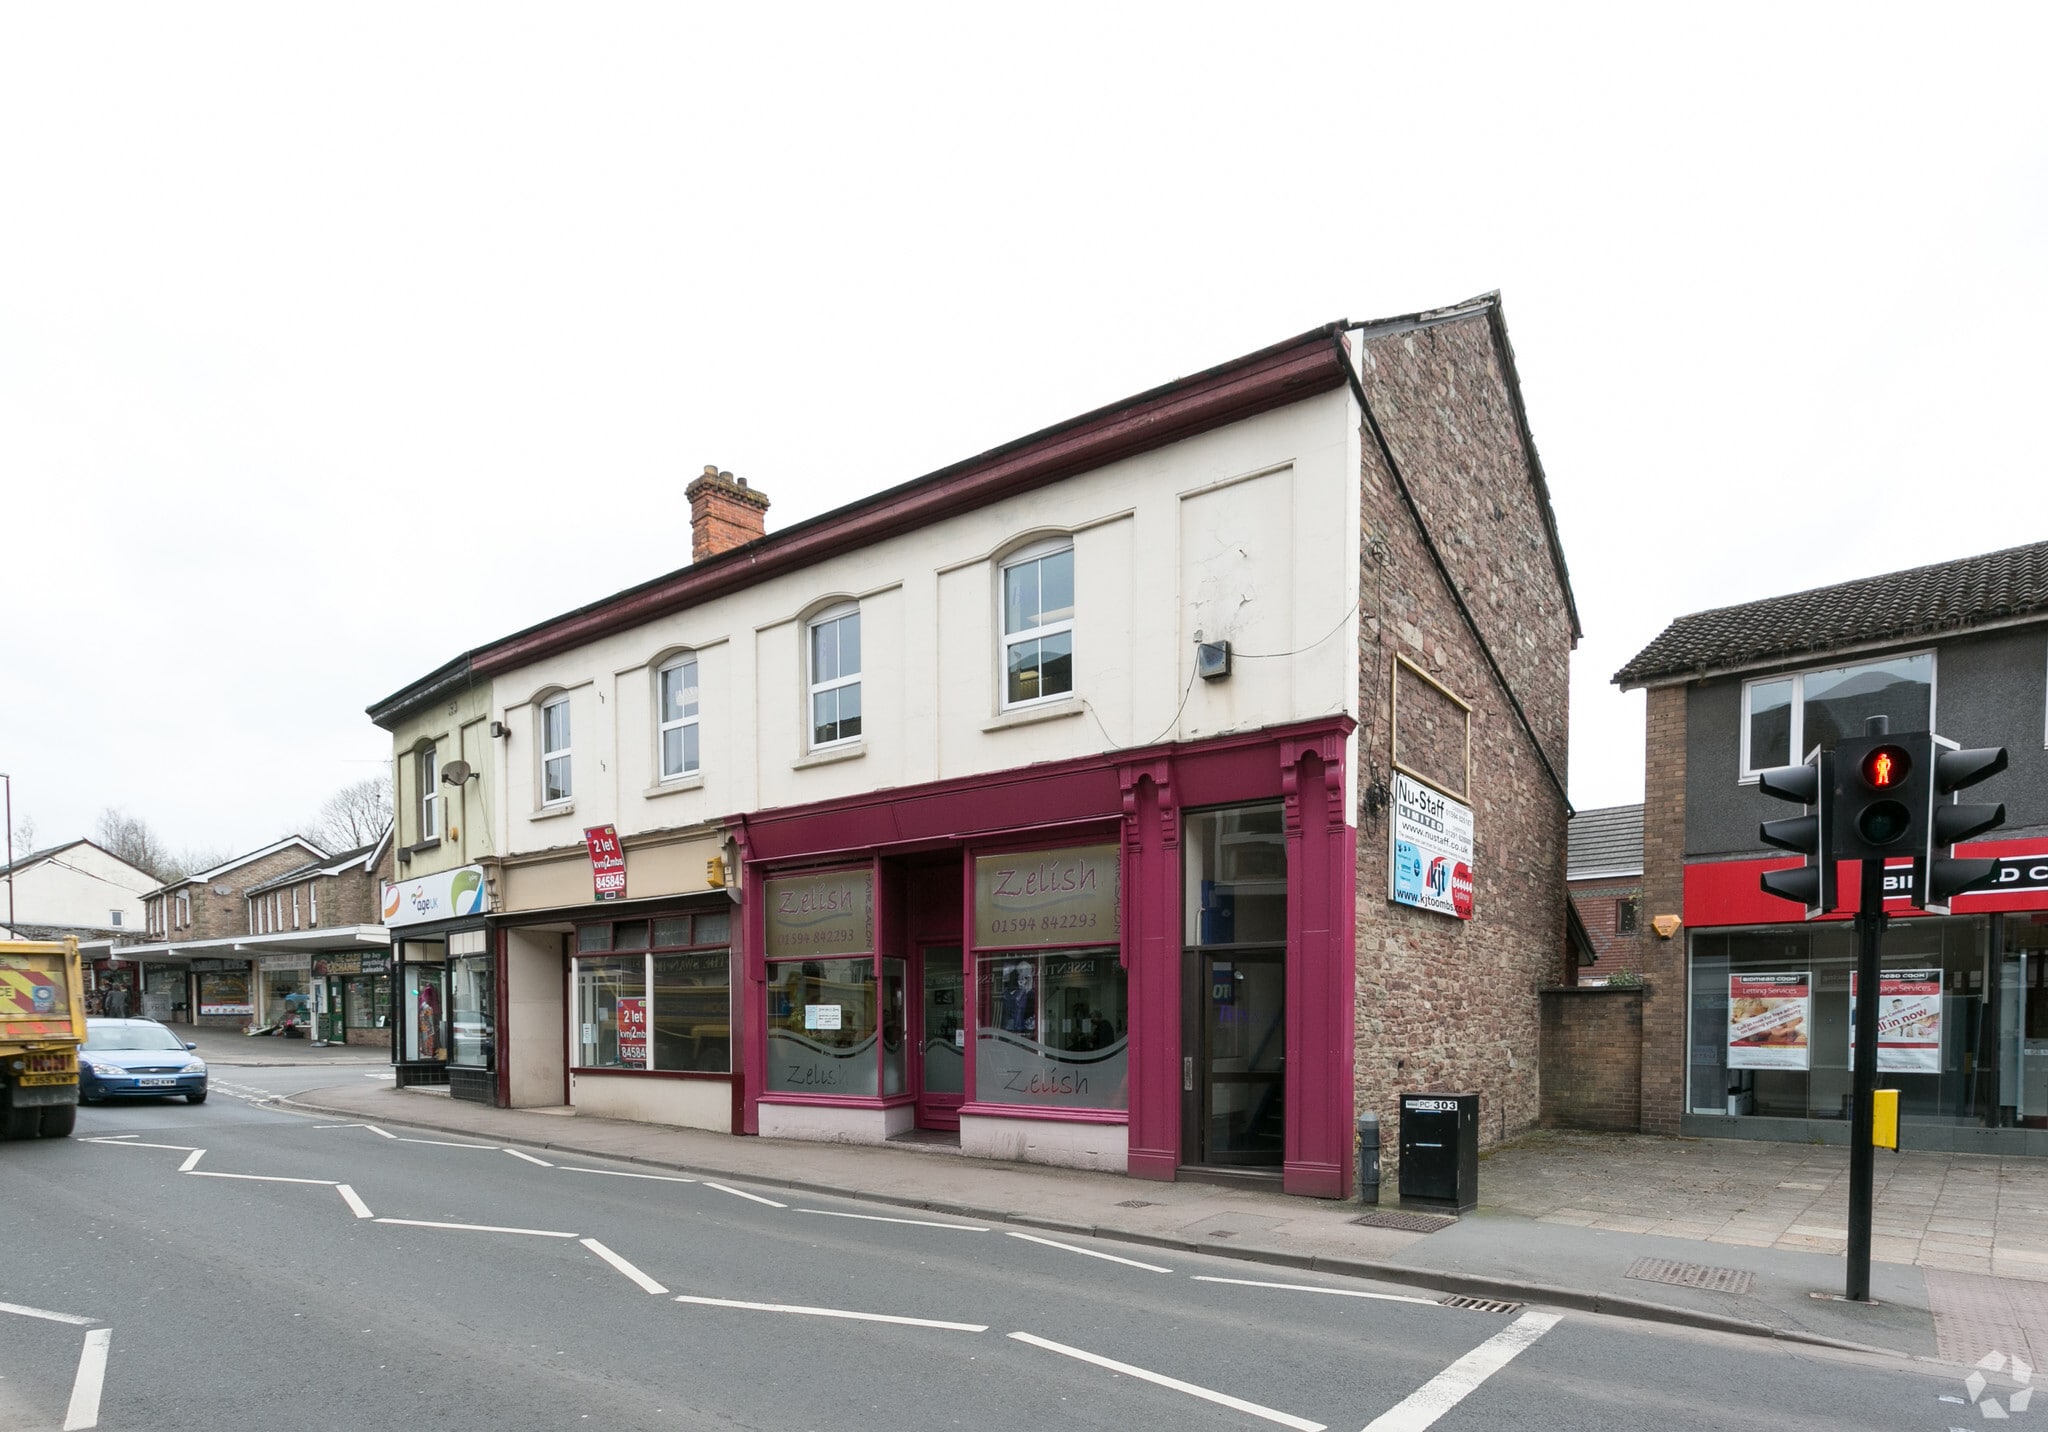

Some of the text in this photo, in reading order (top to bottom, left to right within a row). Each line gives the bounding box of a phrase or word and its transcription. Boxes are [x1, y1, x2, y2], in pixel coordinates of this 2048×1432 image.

[1399, 779, 1444, 819] Nu-Staff
[1400, 804, 1443, 832] LIMITED
[594, 838, 614, 852] 2 let
[1402, 822, 1468, 853] www.nustaff.co.uk
[596, 874, 624, 888] 845845
[1430, 860, 1446, 896] kjt
[416, 899, 430, 915] age
[1397, 889, 1472, 914] www.kjtoombs.co.uk
[992, 912, 1096, 933] 01594 842293
[778, 928, 854, 946] 01594 842293
[1899, 984, 1932, 992] Services
[624, 1010, 644, 1022] 2 let
[1901, 1006, 1927, 1024] now
[622, 1046, 646, 1058] 84584
